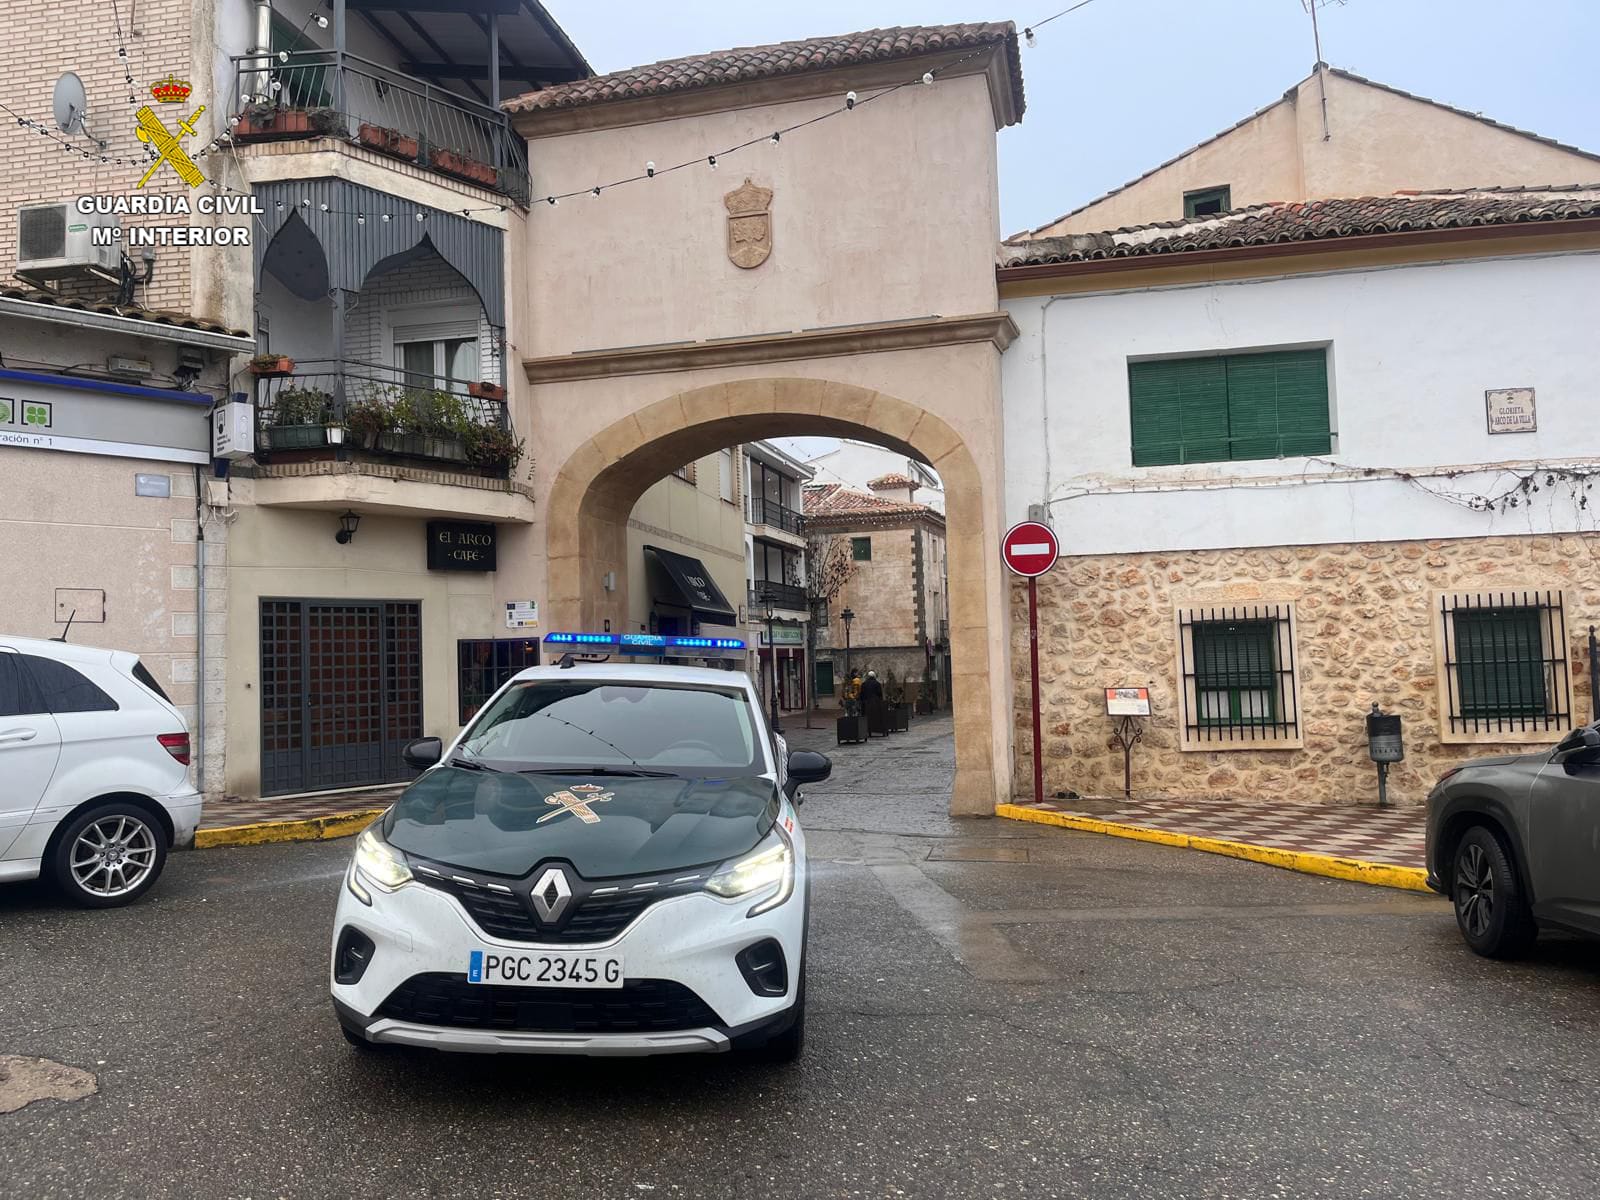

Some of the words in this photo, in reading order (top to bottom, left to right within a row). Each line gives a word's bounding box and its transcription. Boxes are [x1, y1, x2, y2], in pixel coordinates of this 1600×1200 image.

[1499, 407, 1524, 415] GLORIETA
[1495, 416, 1506, 425] ARCO
[1507, 416, 1513, 424] DE
[1513, 416, 1519, 424] LA
[458, 532, 492, 546] ARCO
[472, 969, 478, 977] E
[485, 955, 531, 980] PGC
[536, 957, 598, 983] 2345
[604, 959, 619, 983] G
